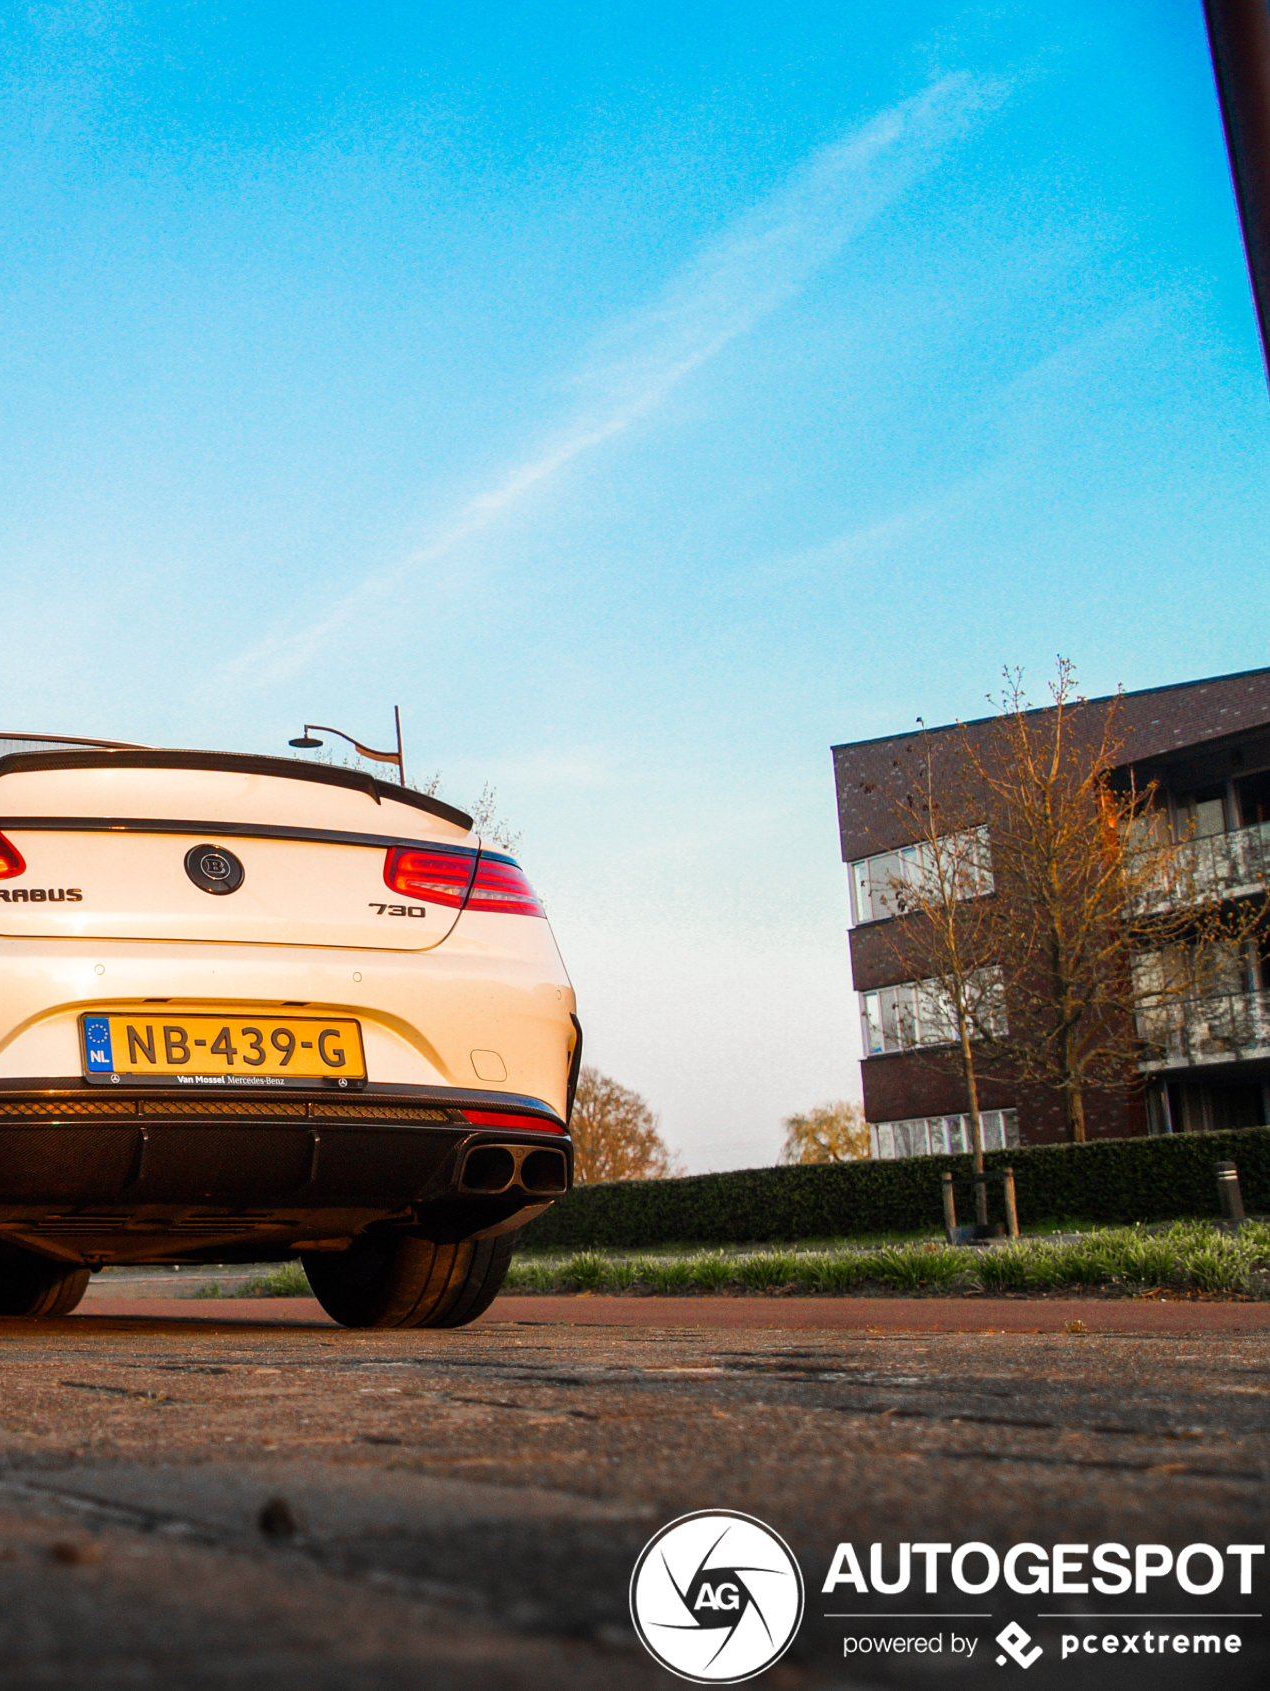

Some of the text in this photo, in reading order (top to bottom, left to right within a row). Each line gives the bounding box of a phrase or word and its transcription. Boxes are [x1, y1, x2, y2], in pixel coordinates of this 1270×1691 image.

[368, 902, 426, 918] 730
[126, 1025, 347, 1068] NB-439-G
[90, 1049, 110, 1064] NL
[176, 1075, 285, 1086] Van Mossel Mercedes-Benz
